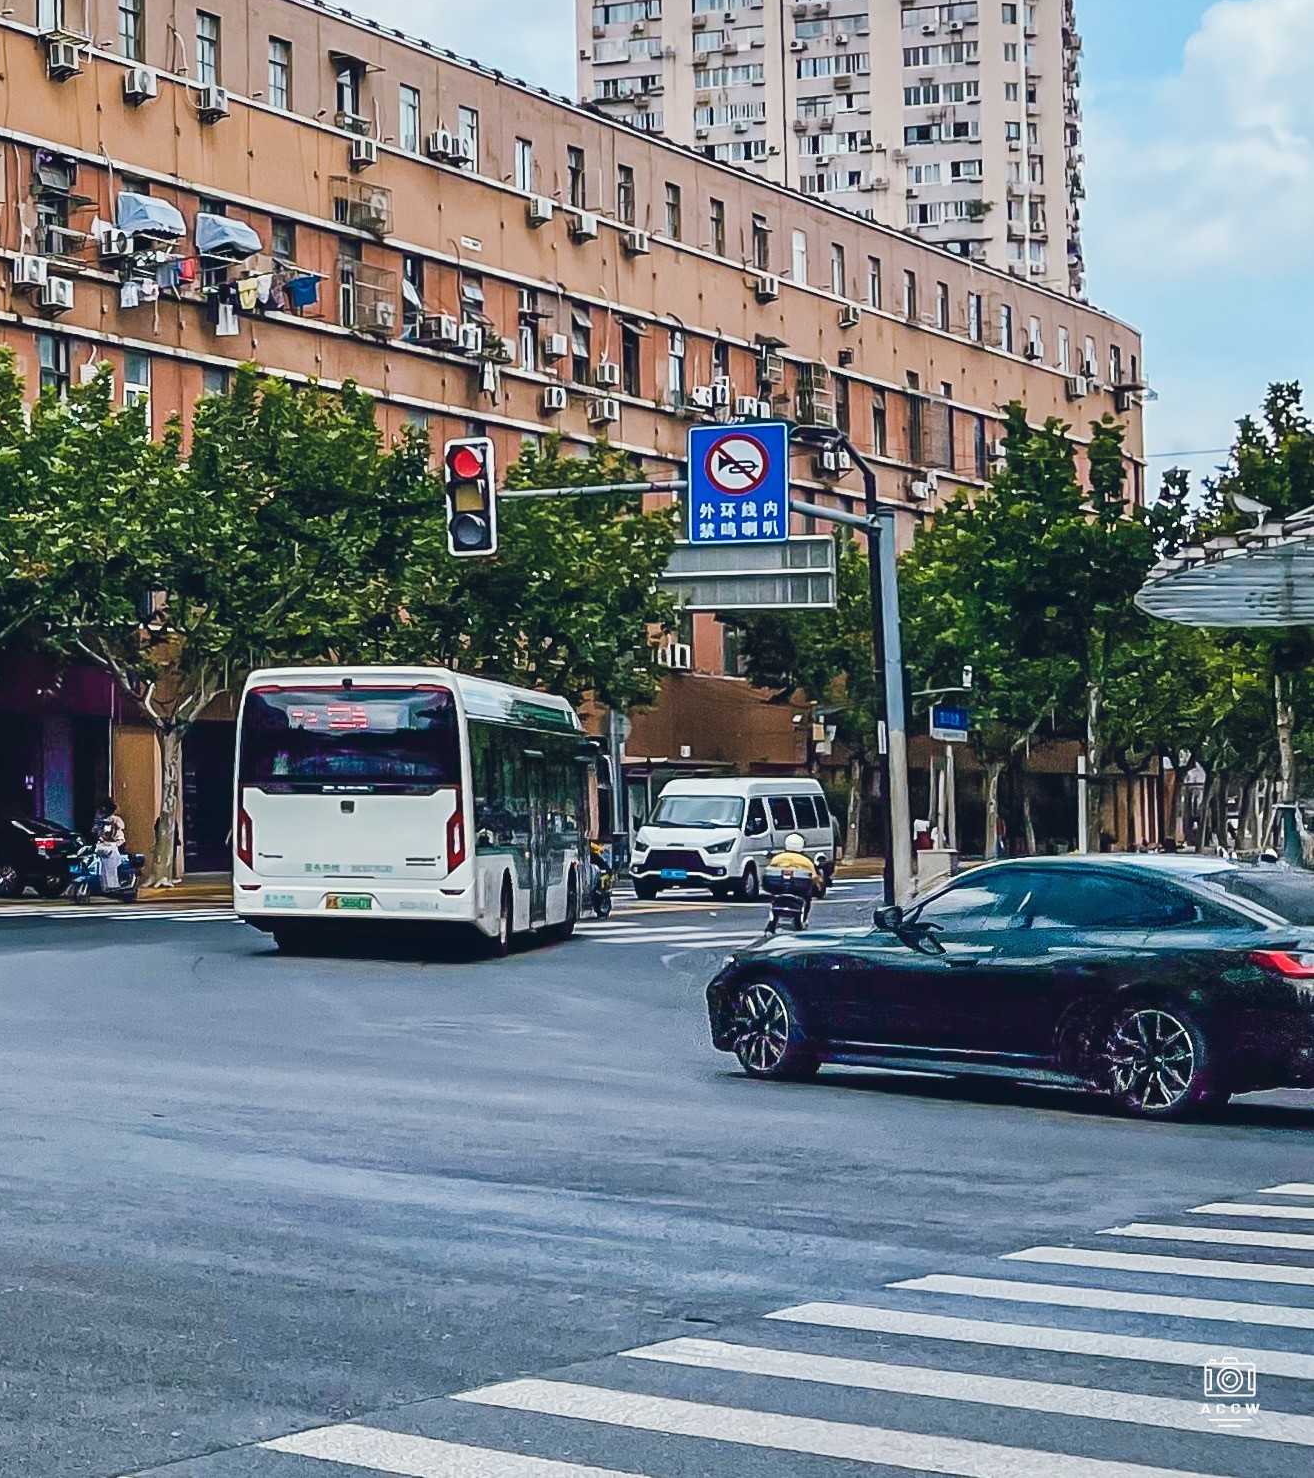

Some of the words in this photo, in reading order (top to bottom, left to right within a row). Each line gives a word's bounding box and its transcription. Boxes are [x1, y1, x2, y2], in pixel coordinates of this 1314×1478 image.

[699, 500, 778, 520] 外环线内
[699, 520, 779, 539] 禁鸣喇叭
